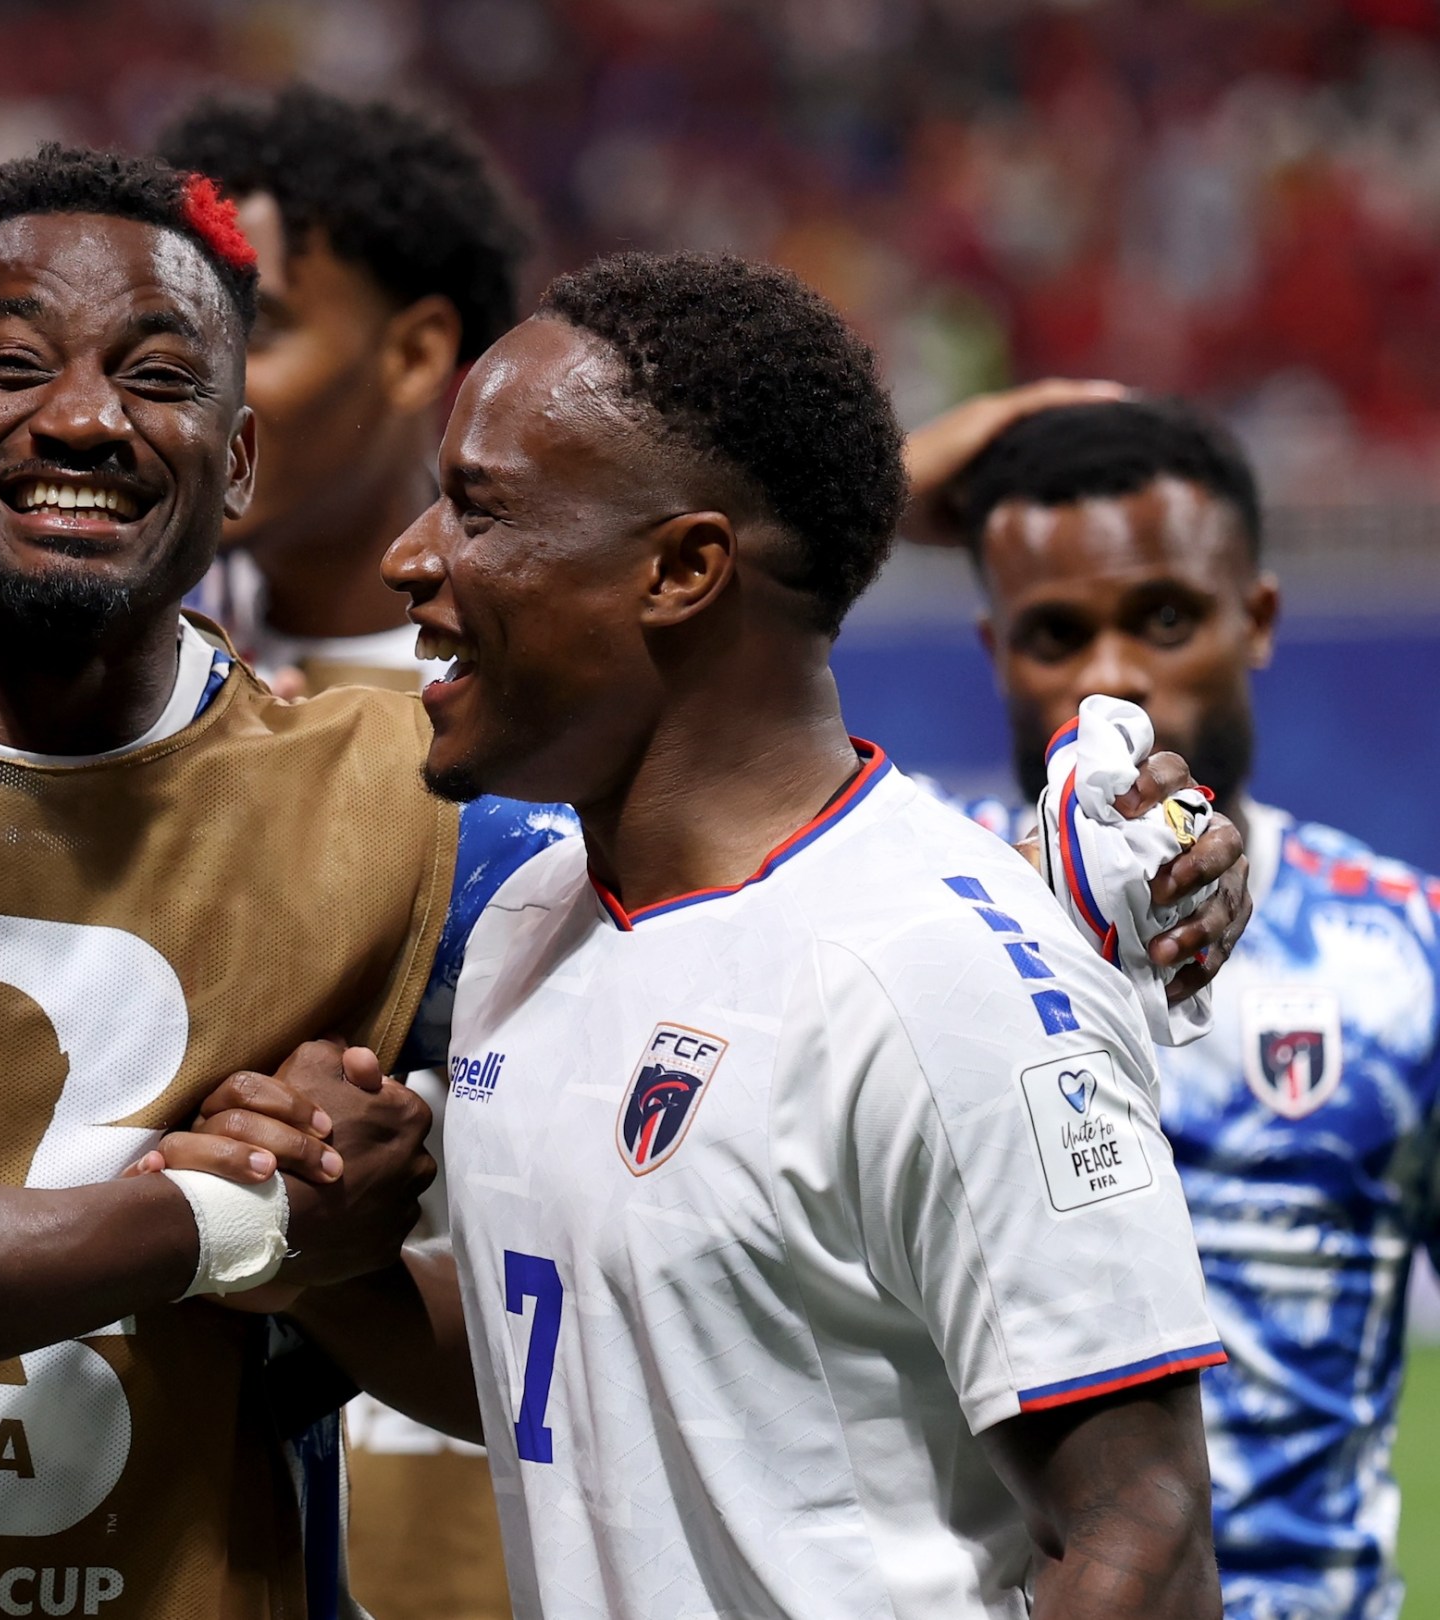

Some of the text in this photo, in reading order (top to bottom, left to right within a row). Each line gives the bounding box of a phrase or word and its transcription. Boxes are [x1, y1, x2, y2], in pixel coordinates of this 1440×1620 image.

[651, 1032, 718, 1061] FCF
[455, 1085, 494, 1104] SPORT
[1061, 1119, 1097, 1150] Unite
[1071, 1140, 1122, 1177] PEACE
[1089, 1174, 1117, 1191] FIFA
[504, 1249, 564, 1464] 7
